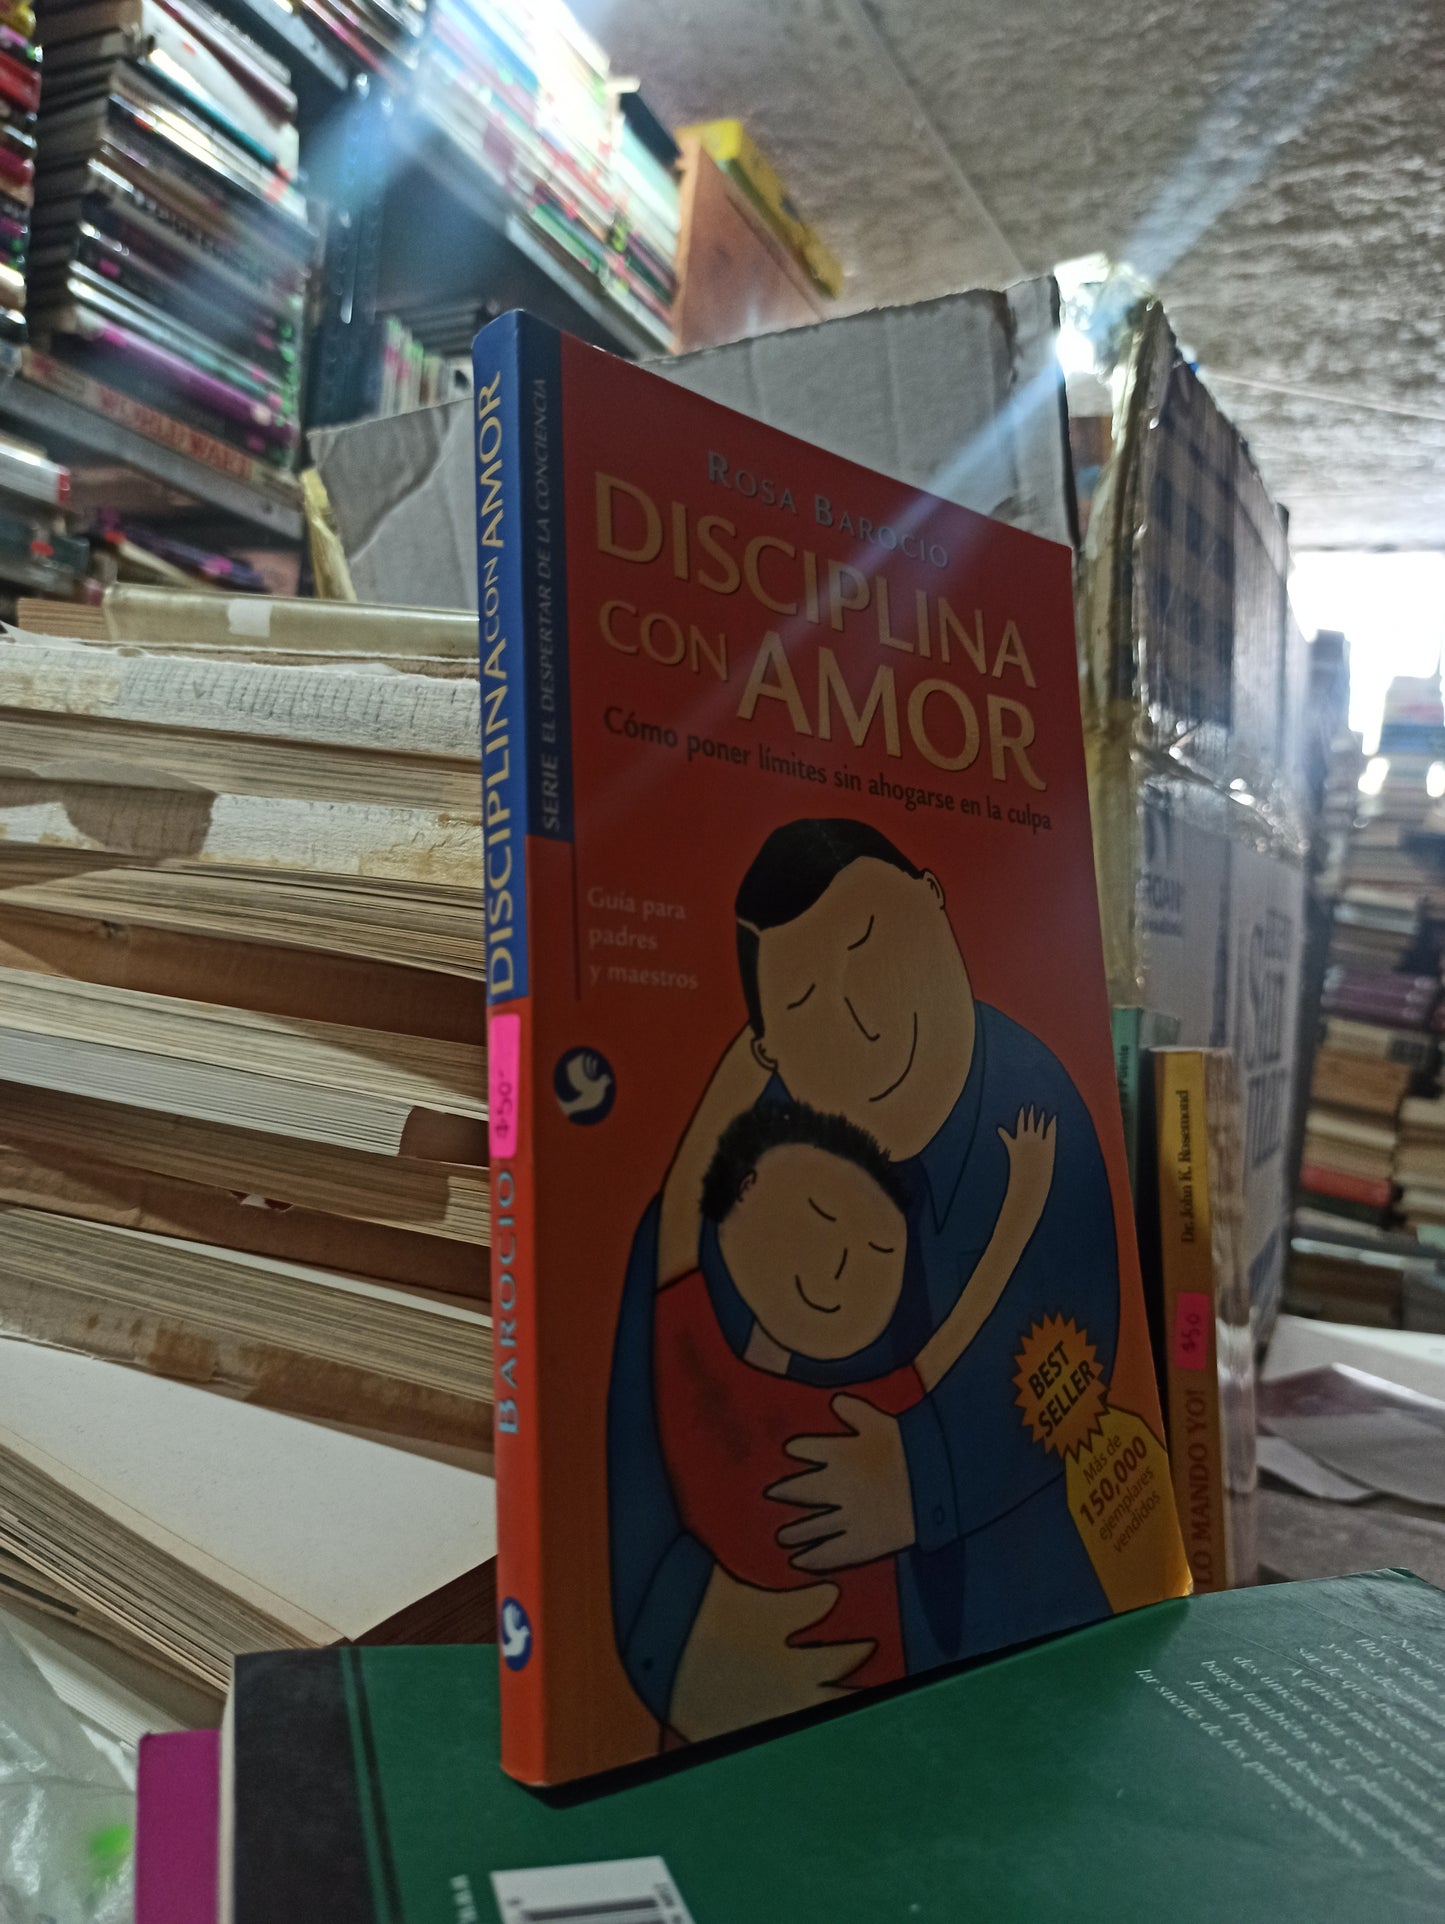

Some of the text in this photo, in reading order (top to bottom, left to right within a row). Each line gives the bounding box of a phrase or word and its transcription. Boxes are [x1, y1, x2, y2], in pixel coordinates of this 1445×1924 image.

[707, 451, 950, 569] ROSA BAROCIO
[533, 379, 560, 832] SERIE EL DESPERTAR DE LA CONCIENCIA
[594, 471, 1038, 689] DISCIPLINA
[479, 370, 514, 995] DISCIPLINA CON AMOR
[600, 600, 1048, 791] CON AMOR
[603, 706, 1051, 834] Cómo poner límites sin ahogarse en la culpa
[586, 886, 686, 923] Guía para
[588, 924, 657, 950] padres
[589, 962, 698, 990] y maestros
[1176, 1089, 1191, 1166] Rosemond
[497, 1171, 519, 1434] BAROCIO
[1027, 1340, 1071, 1400] BEST
[1038, 1359, 1096, 1438] SELLER
[1079, 1436, 1149, 1526] 150,000
[1083, 1432, 1123, 1485] Más de
[1189, 1441, 1210, 1544] MANDO
[1100, 1466, 1155, 1541] ejemplares
[1113, 1490, 1161, 1553] vendidos
